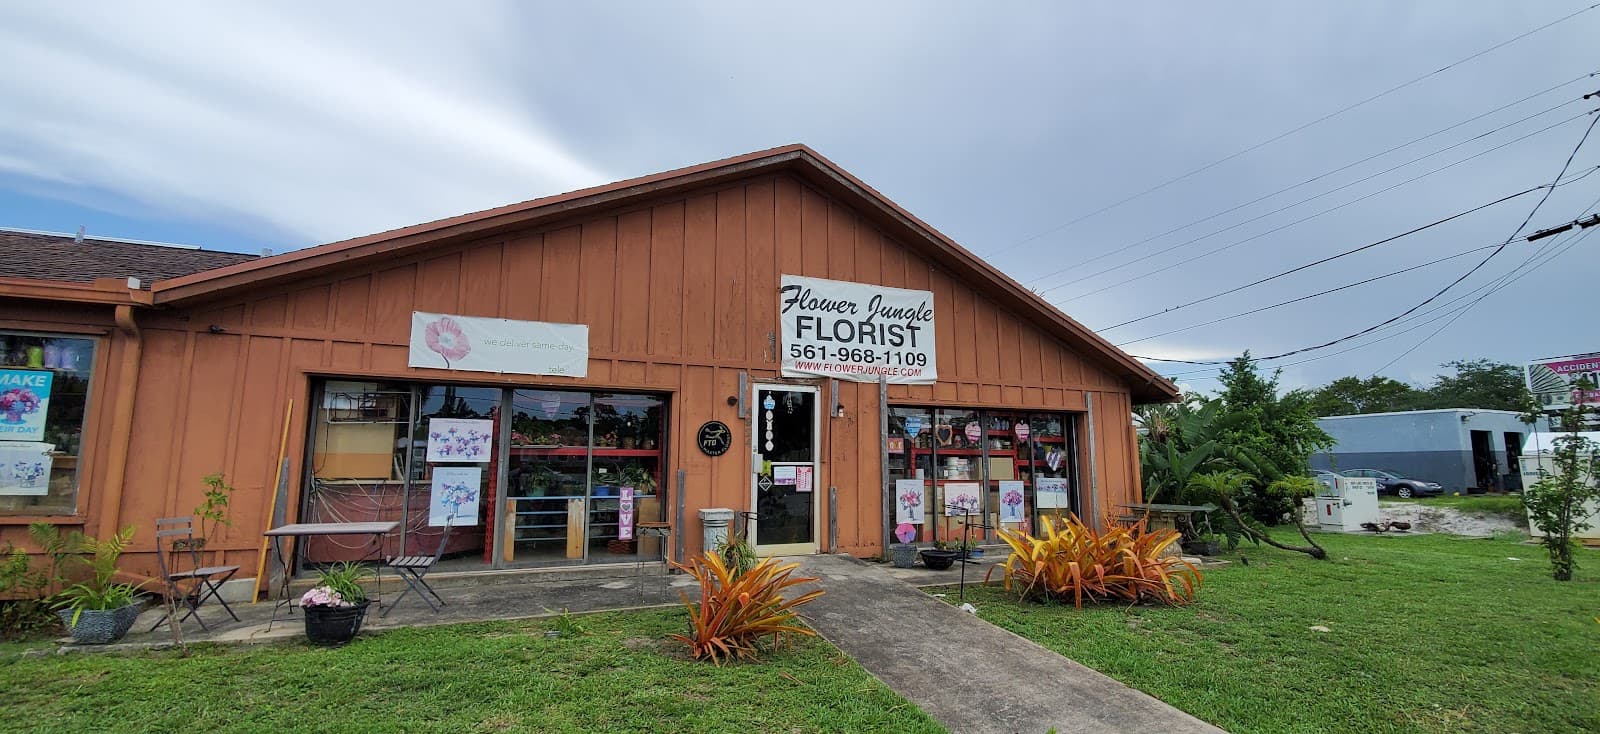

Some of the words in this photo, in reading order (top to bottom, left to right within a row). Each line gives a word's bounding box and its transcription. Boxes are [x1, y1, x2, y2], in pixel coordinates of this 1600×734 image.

[781, 285, 859, 315] Flower
[864, 294, 933, 329] Jungle
[796, 316, 921, 347] FLORIST
[484, 338, 498, 347] we
[790, 344, 927, 366] 561-968-1109
[795, 361, 922, 376] WWW.FLOWERJUNGLE.COM
[1557, 362, 1600, 372] ACCIDEN
[0, 373, 47, 387] MAKE
